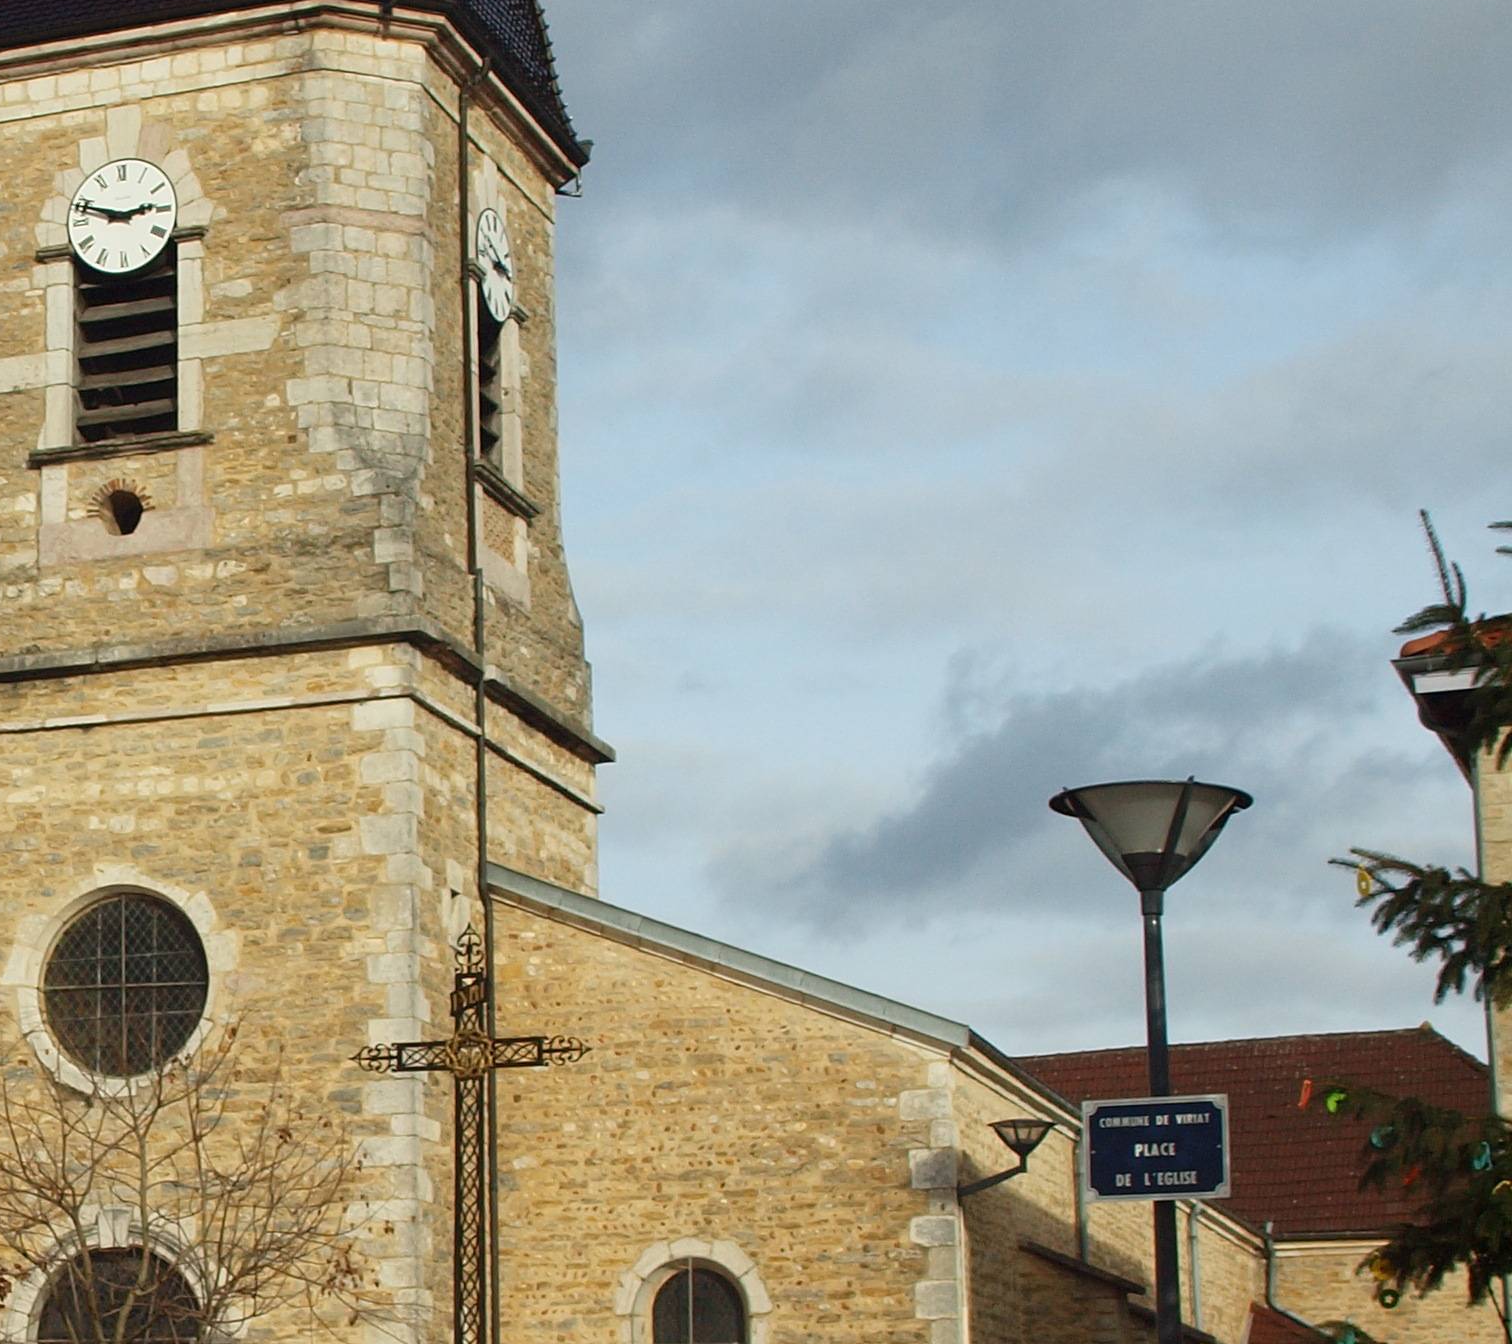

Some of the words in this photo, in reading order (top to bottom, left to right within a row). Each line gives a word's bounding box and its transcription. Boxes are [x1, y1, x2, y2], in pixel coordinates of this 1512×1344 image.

[1099, 1116, 1150, 1128] COMMUNE
[1155, 1115, 1170, 1126] DE
[1175, 1113, 1210, 1125] VIRIAT
[1134, 1142, 1176, 1157] PLACE
[1115, 1173, 1132, 1187] DE
[1144, 1171, 1197, 1186] L'EGLISE
